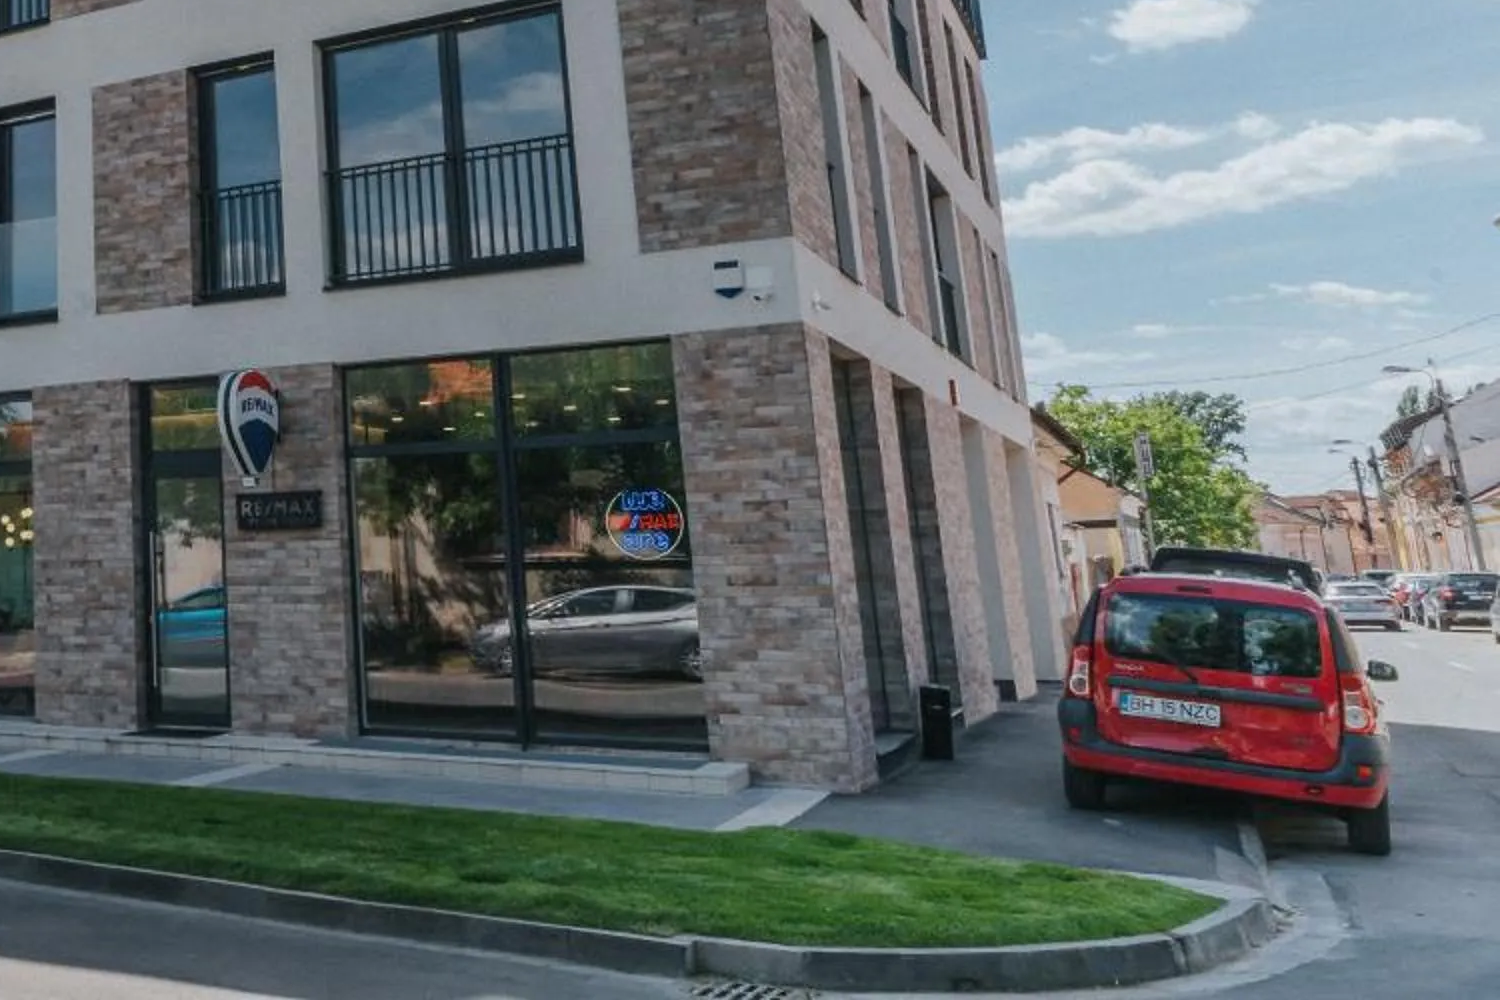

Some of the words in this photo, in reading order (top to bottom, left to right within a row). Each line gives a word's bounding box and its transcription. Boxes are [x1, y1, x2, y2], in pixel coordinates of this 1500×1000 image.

[241, 397, 274, 417] RE/MAX
[240, 497, 316, 518] RE/MAX
[1161, 700, 1176, 715] 15
[1180, 703, 1218, 721] NZC
